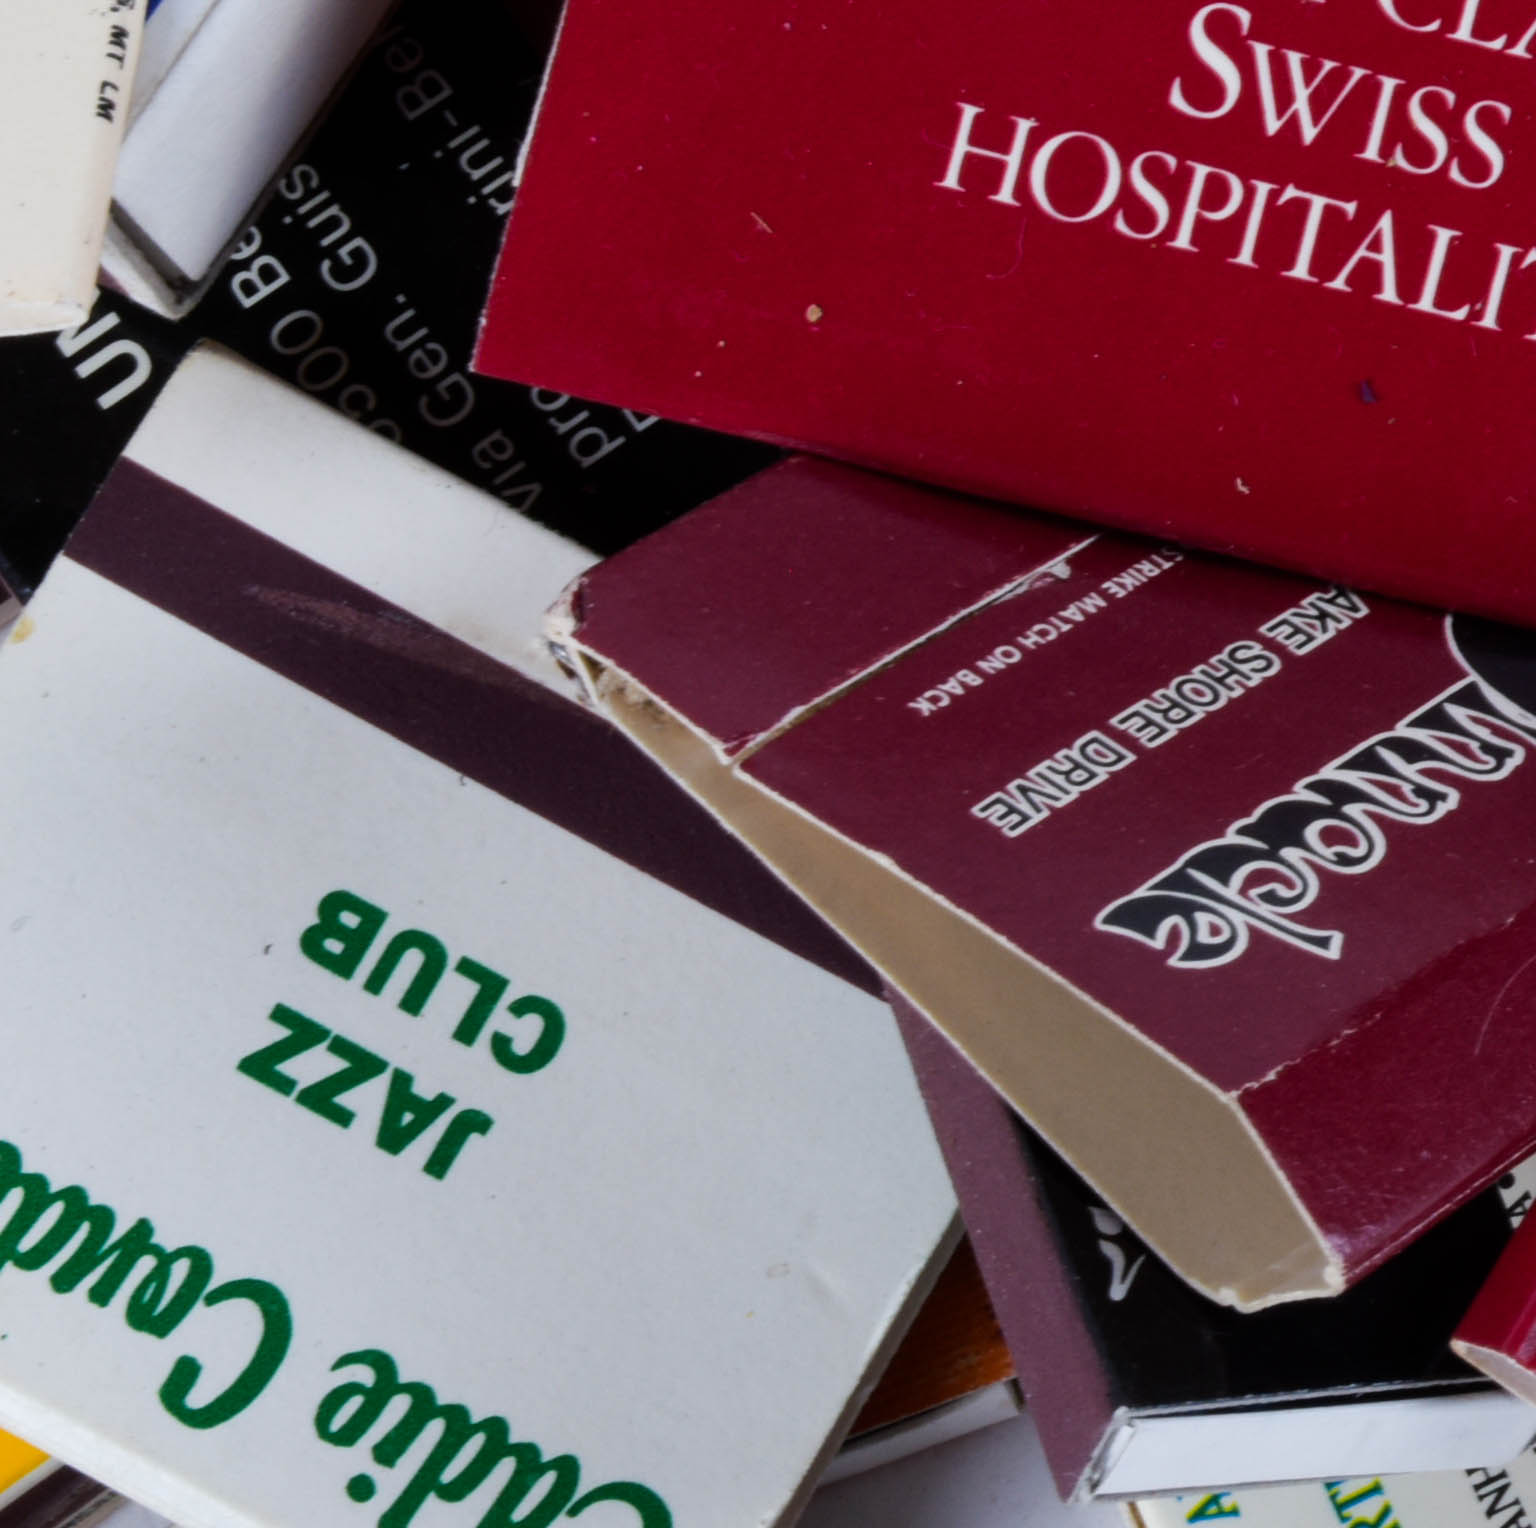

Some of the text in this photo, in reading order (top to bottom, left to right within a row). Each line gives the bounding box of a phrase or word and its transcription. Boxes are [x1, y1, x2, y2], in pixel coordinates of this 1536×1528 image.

[95, 79, 120, 124] LM
[105, 24, 130, 70] MT
[1167, 1, 1514, 190] SWISS
[384, 293, 476, 428] Gen.
[907, 544, 1184, 717] STRIKE MATCH ON BACK
[1111, 638, 1283, 748] SHORE
[970, 727, 1139, 838] DRIVE
[299, 888, 567, 1075] CLUB
[236, 1001, 496, 1182] JAZZ
